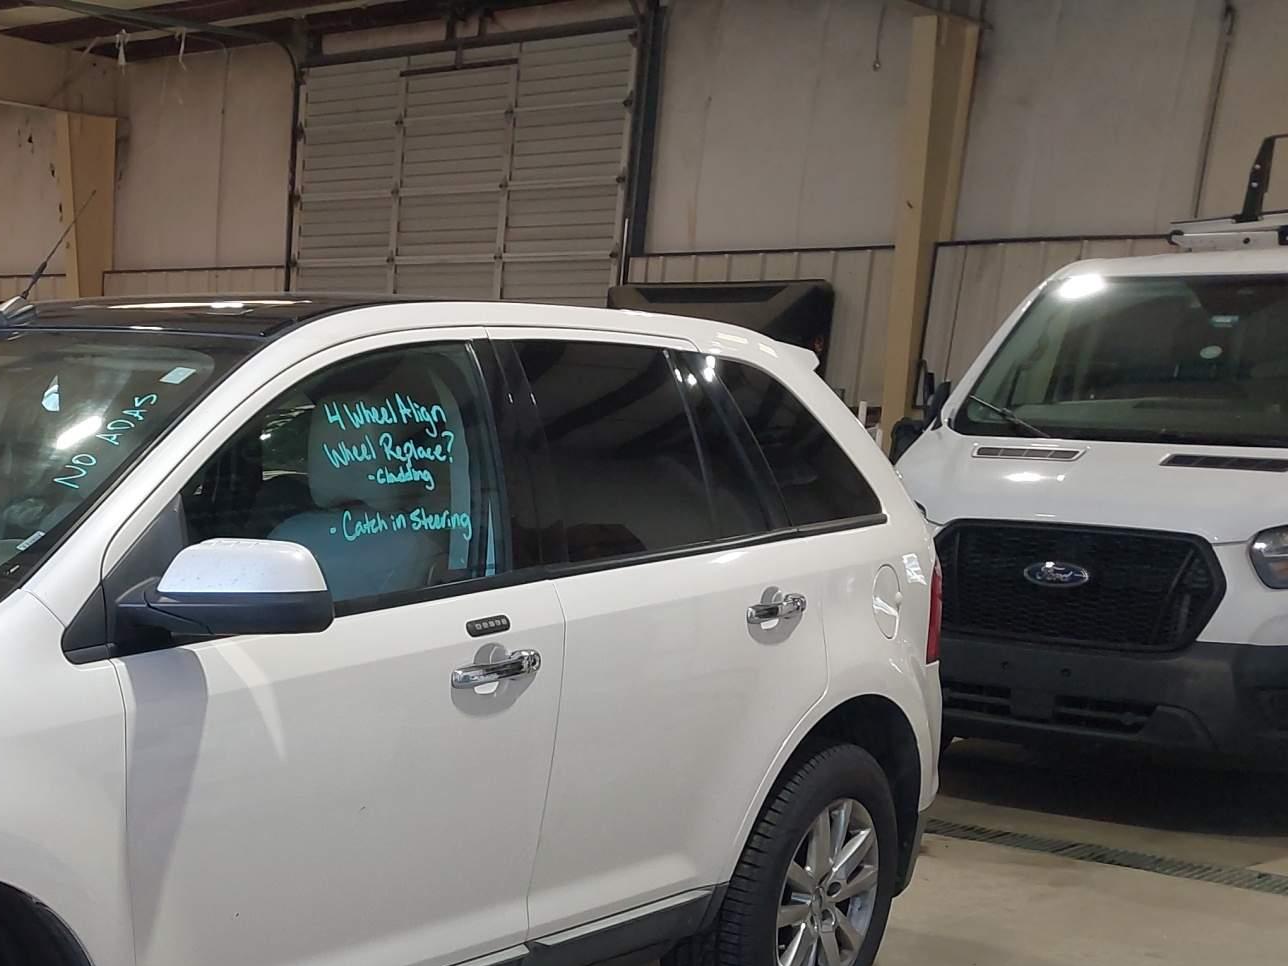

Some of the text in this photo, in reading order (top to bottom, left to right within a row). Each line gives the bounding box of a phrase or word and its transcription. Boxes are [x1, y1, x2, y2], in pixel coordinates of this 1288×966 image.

[324, 392, 447, 438] 4 Wheel Align
[53, 393, 158, 489] NO ADAS
[323, 430, 455, 468] Wheel Replace?
[391, 513, 407, 531] in
[409, 506, 473, 542] Steering
